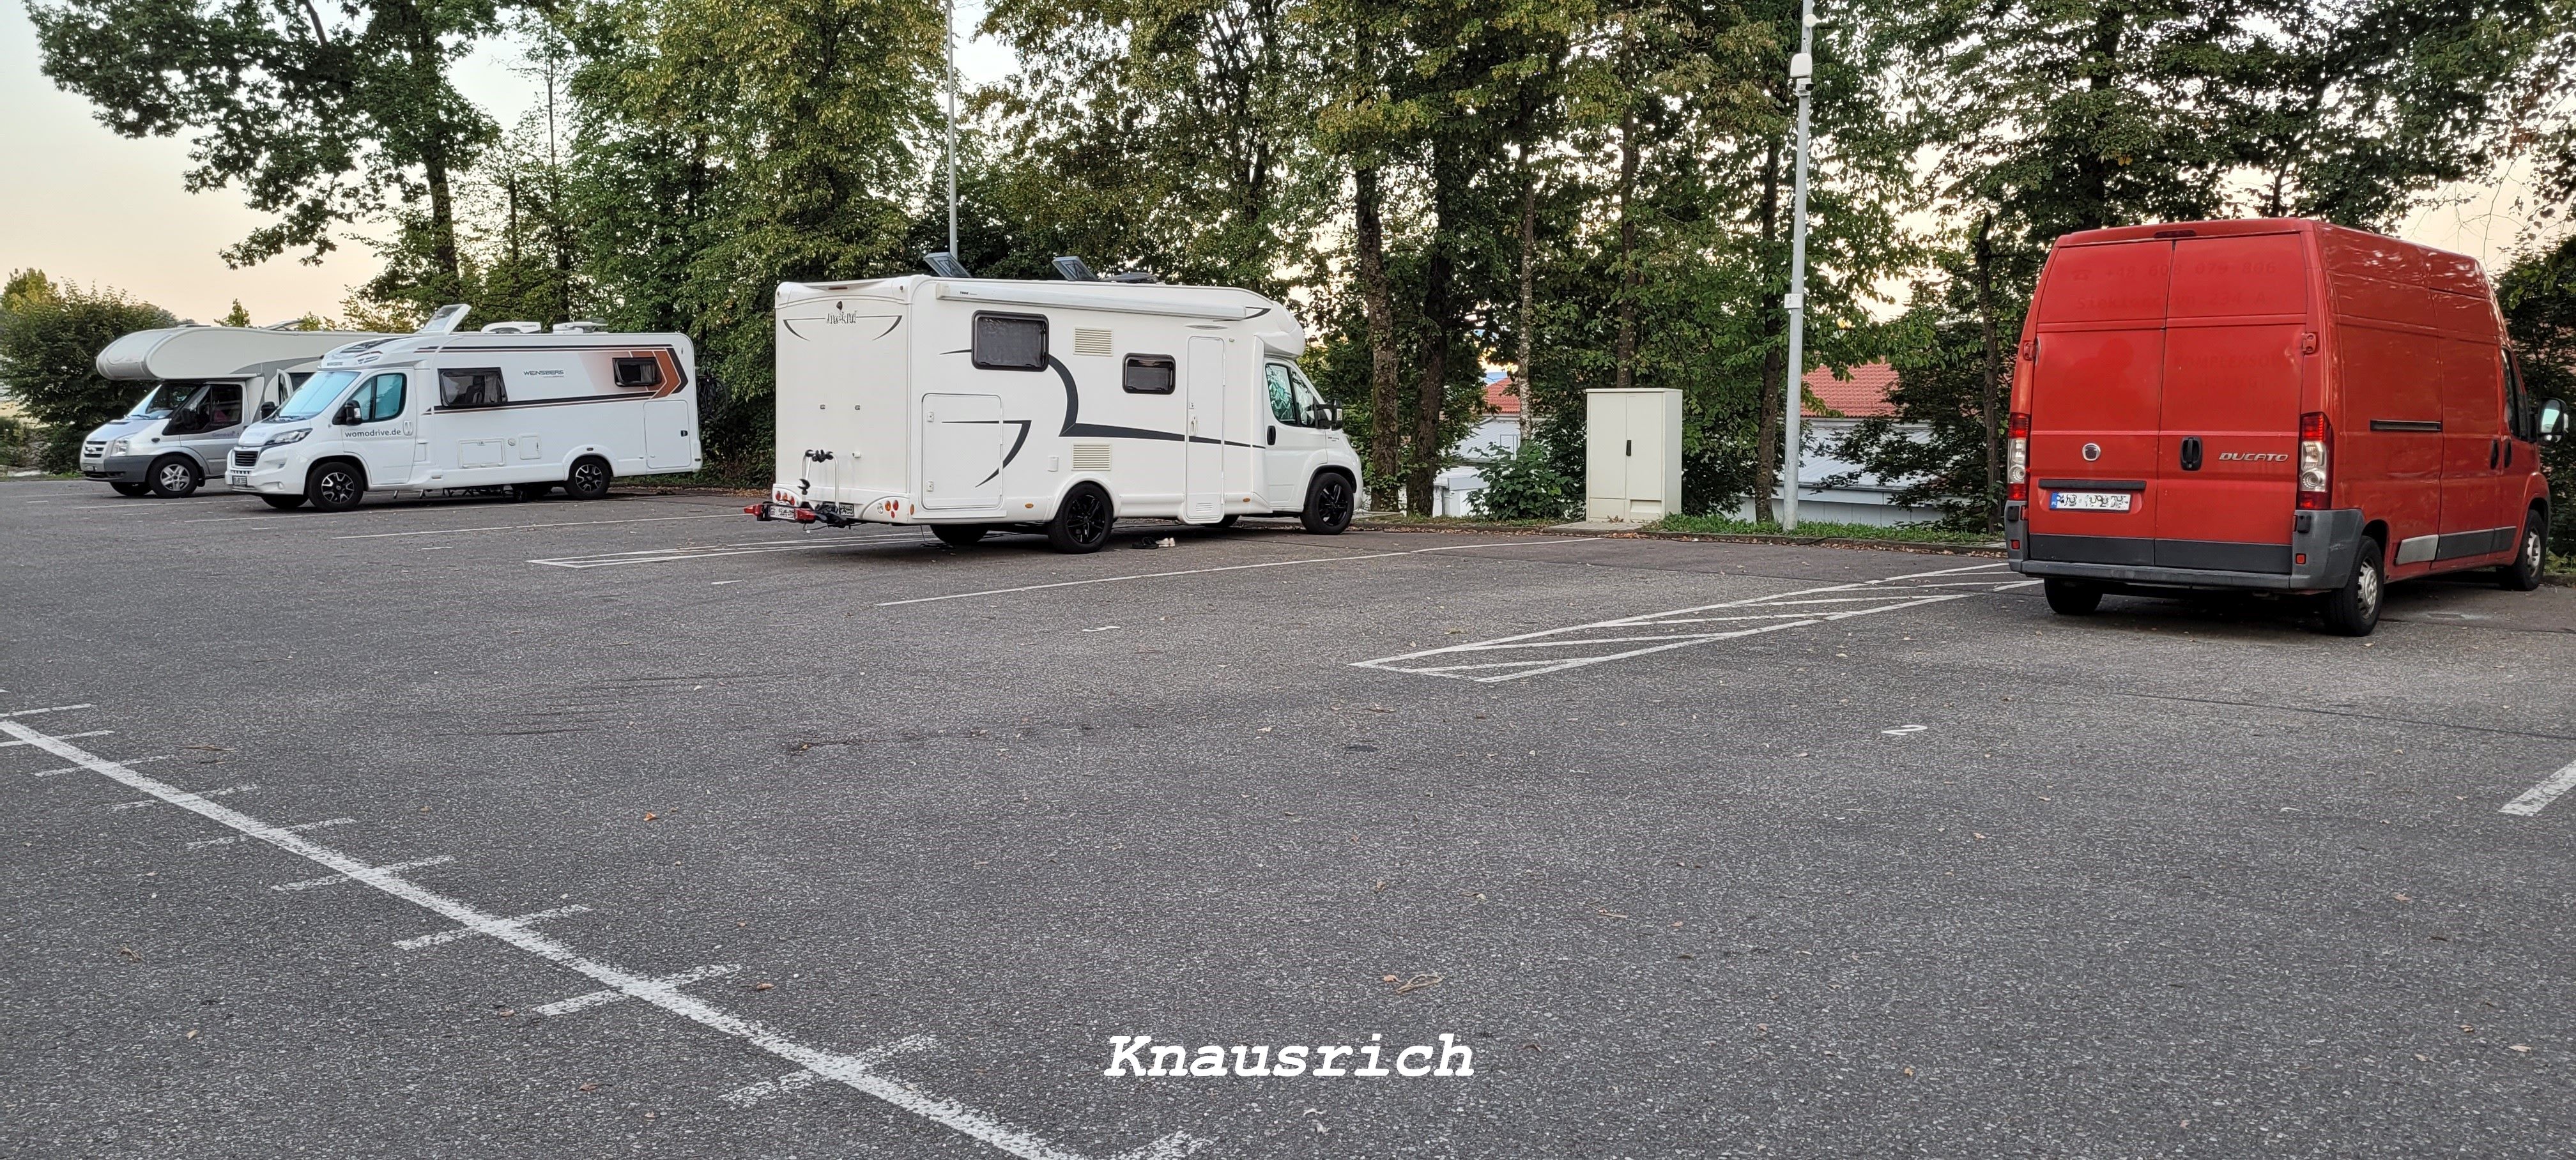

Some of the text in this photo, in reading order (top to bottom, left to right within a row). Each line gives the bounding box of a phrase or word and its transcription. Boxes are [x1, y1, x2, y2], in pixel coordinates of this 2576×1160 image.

[345, 429, 401, 438] womodrive.de
[2218, 452, 2288, 462] DUCATO
[1880, 724, 1928, 736] 2
